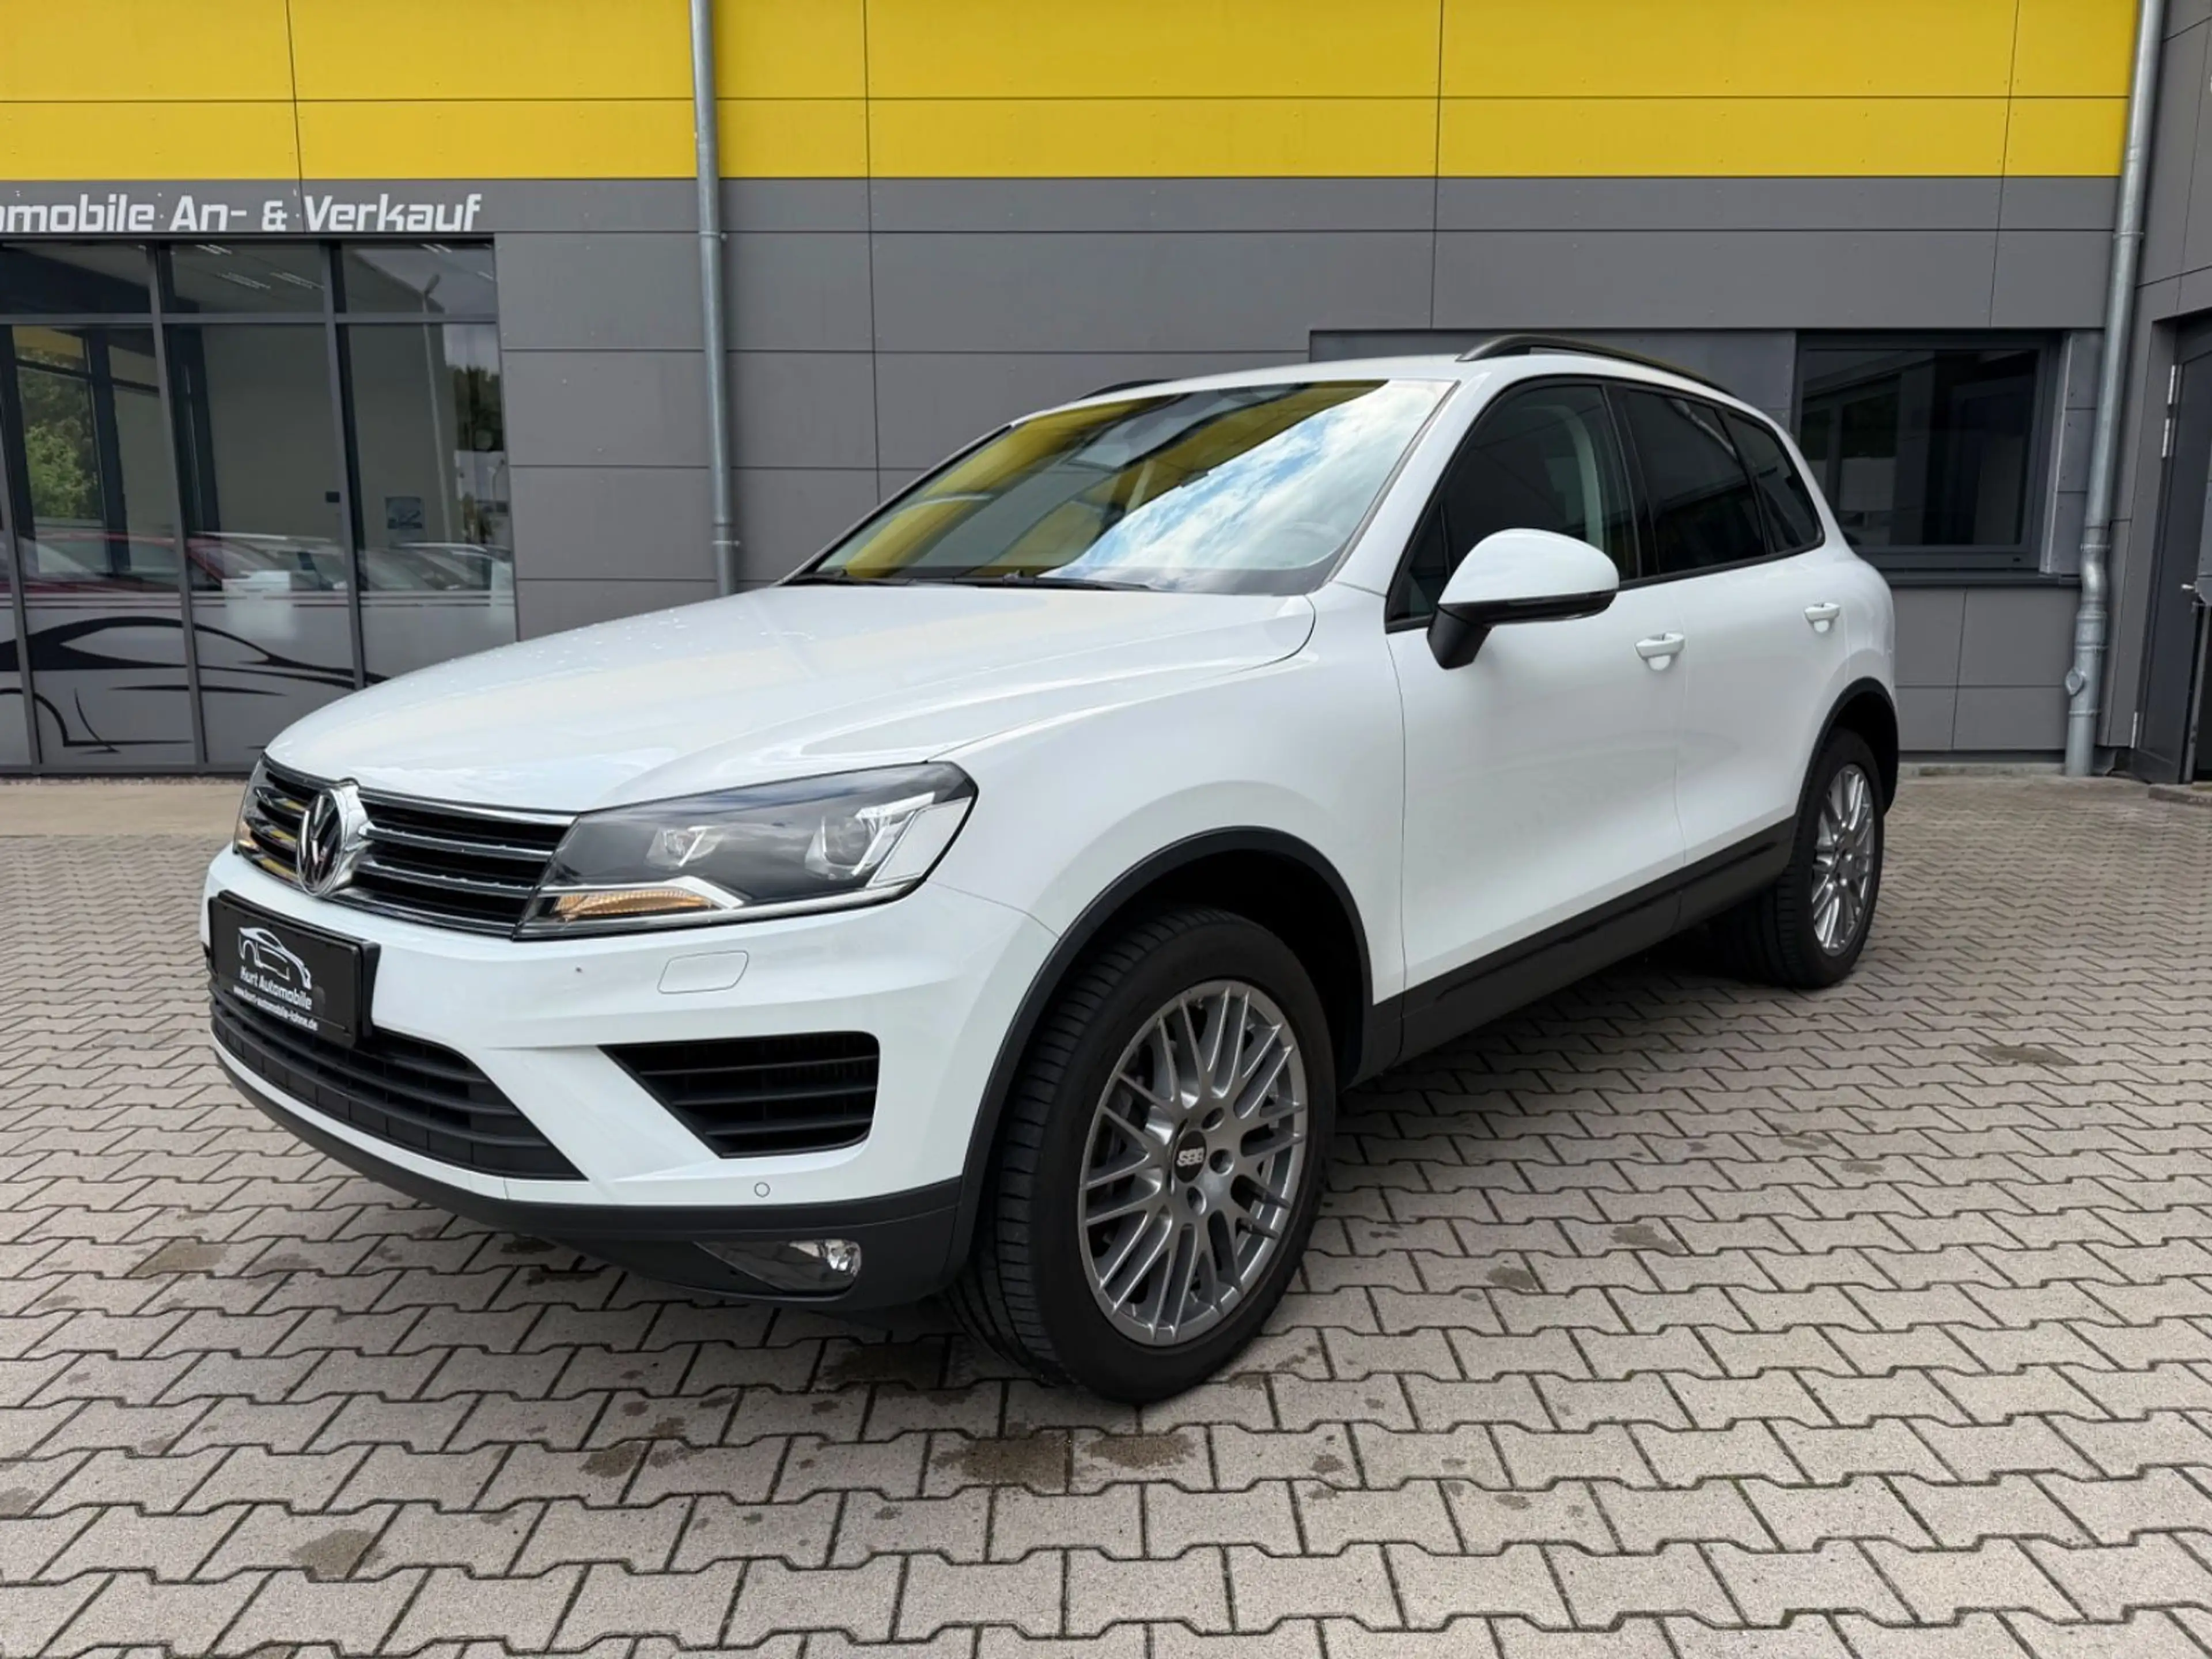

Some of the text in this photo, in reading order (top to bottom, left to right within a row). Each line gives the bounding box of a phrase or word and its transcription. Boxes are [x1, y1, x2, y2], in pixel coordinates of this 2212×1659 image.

[0, 193, 482, 232] mobile An- & Verkauf
[258, 975, 312, 1010] Automobile
